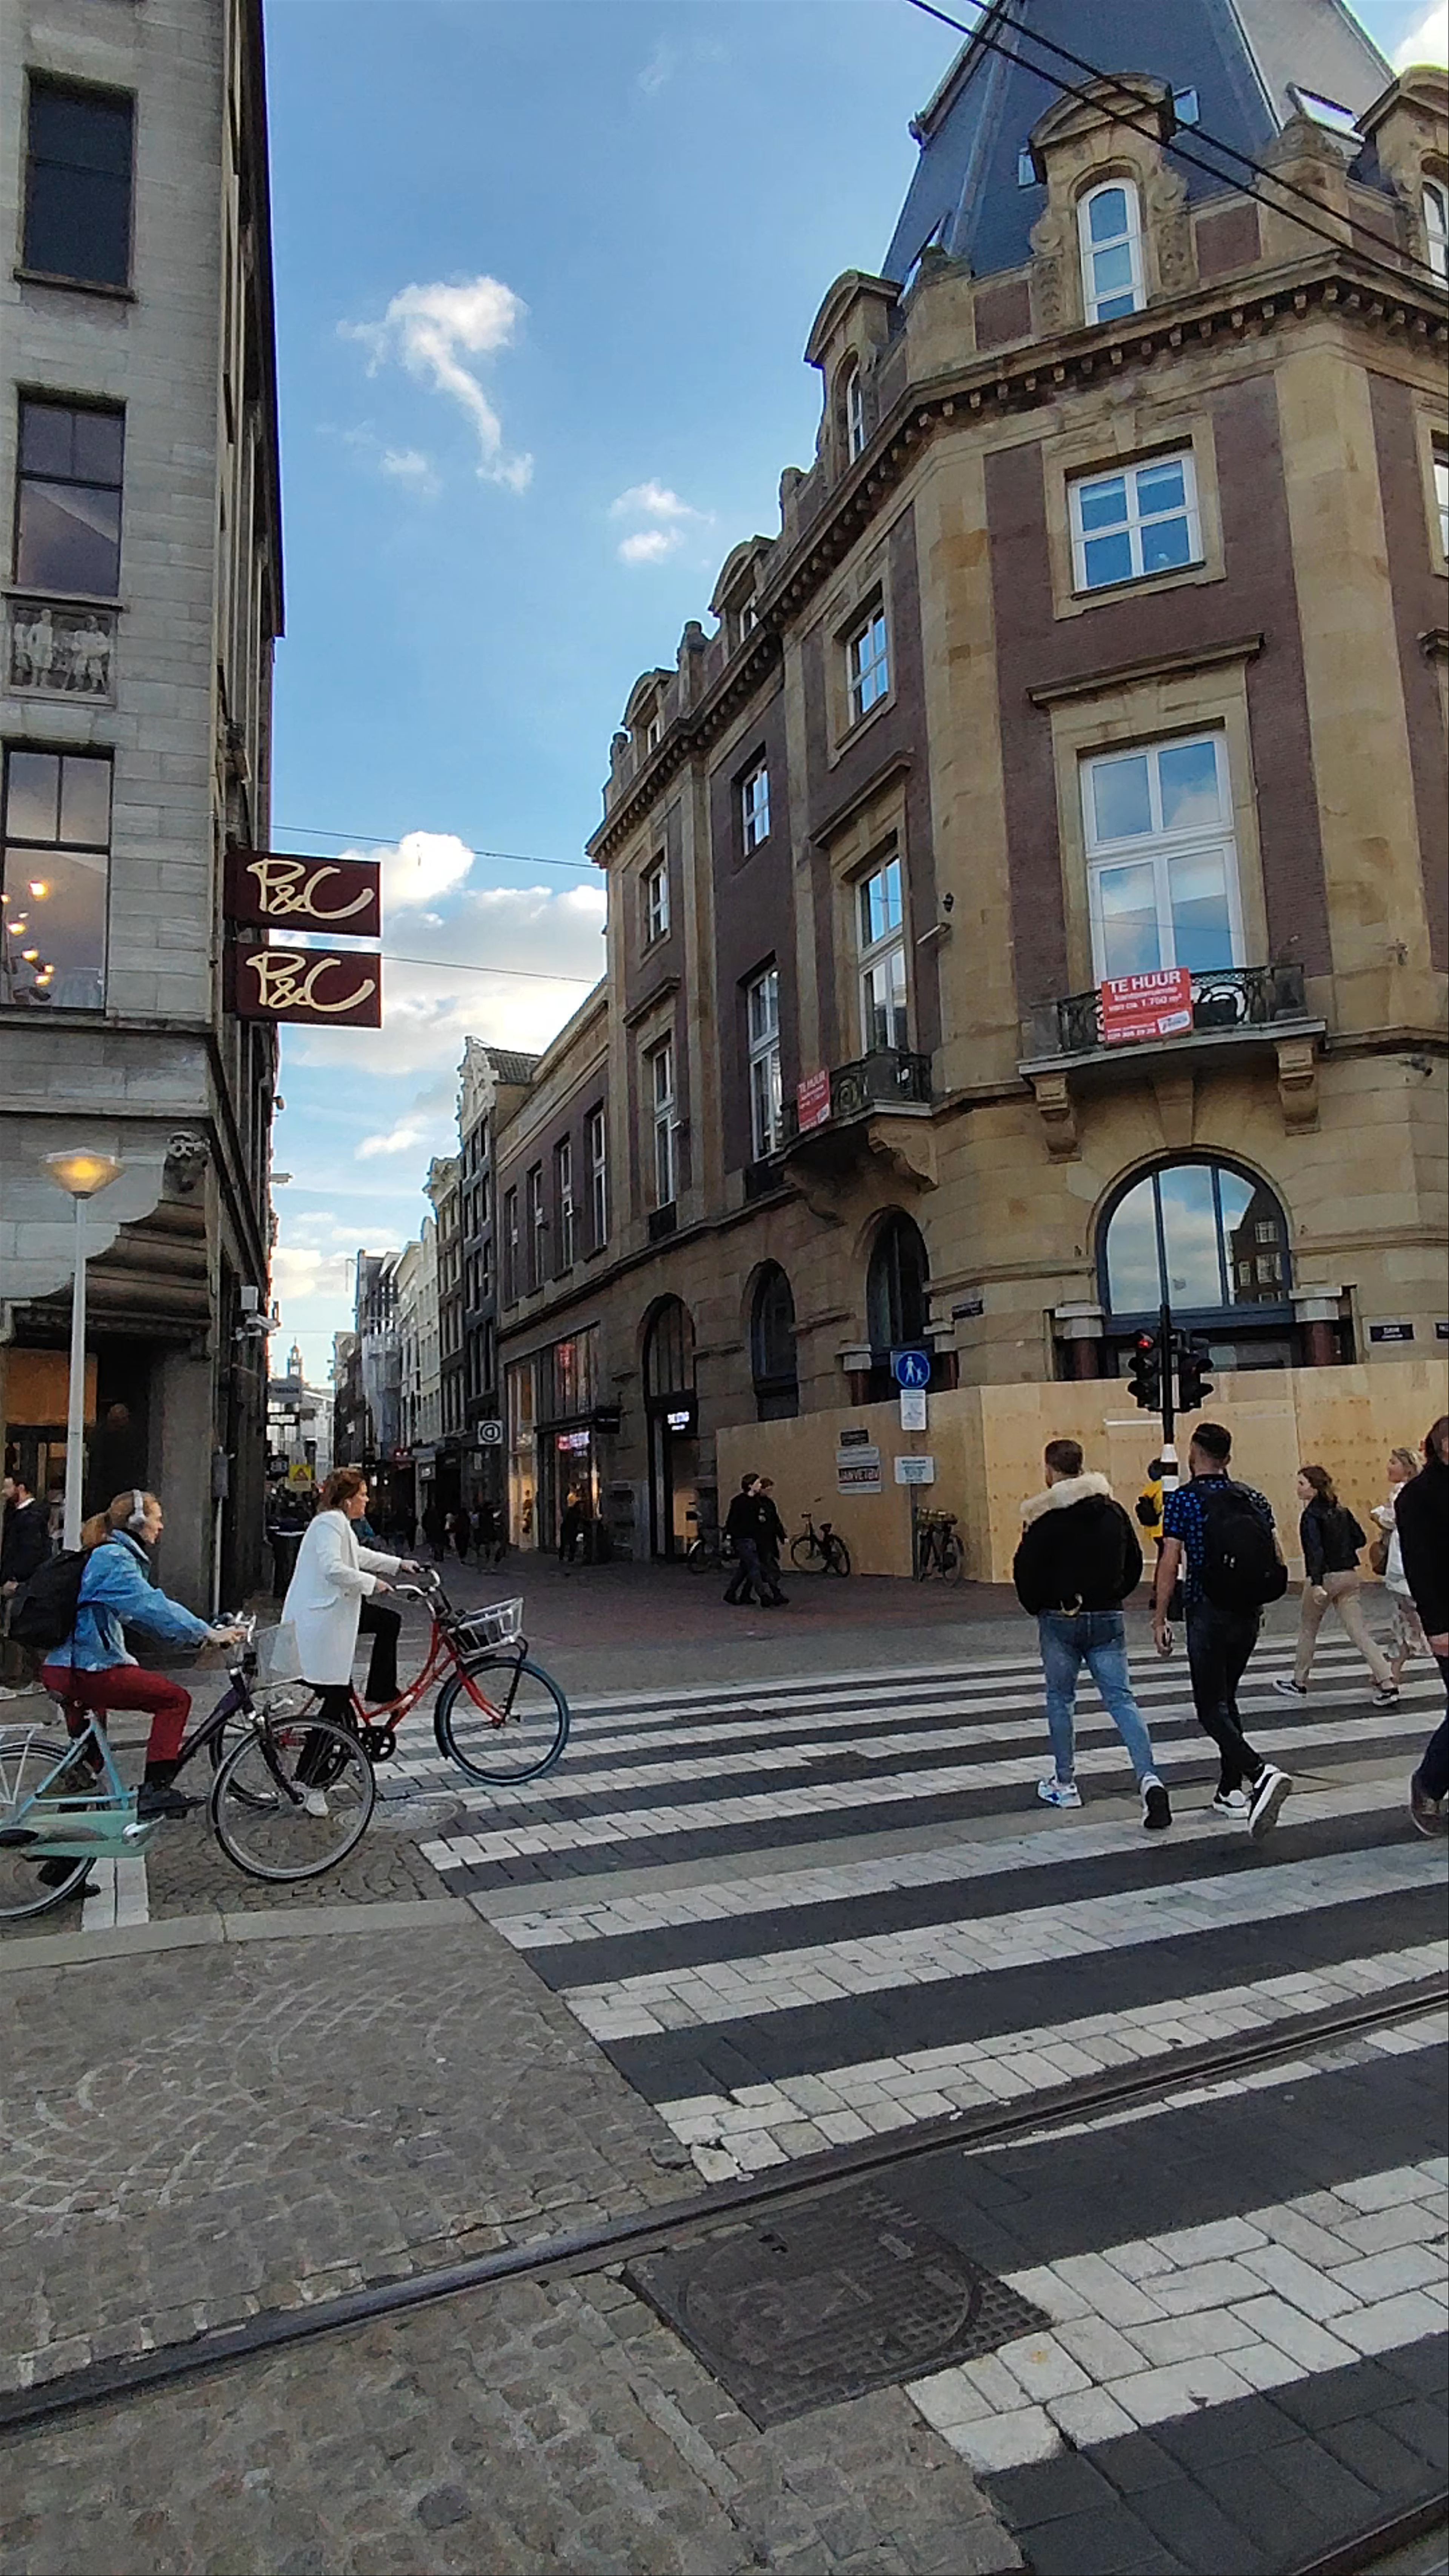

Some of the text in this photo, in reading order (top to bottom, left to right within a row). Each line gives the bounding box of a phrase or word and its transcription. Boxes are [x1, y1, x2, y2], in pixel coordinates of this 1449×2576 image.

[246, 858, 375, 920] P&C
[246, 950, 376, 1012] P&C
[1107, 978, 1129, 994] TE
[1131, 970, 1181, 990] HUUR
